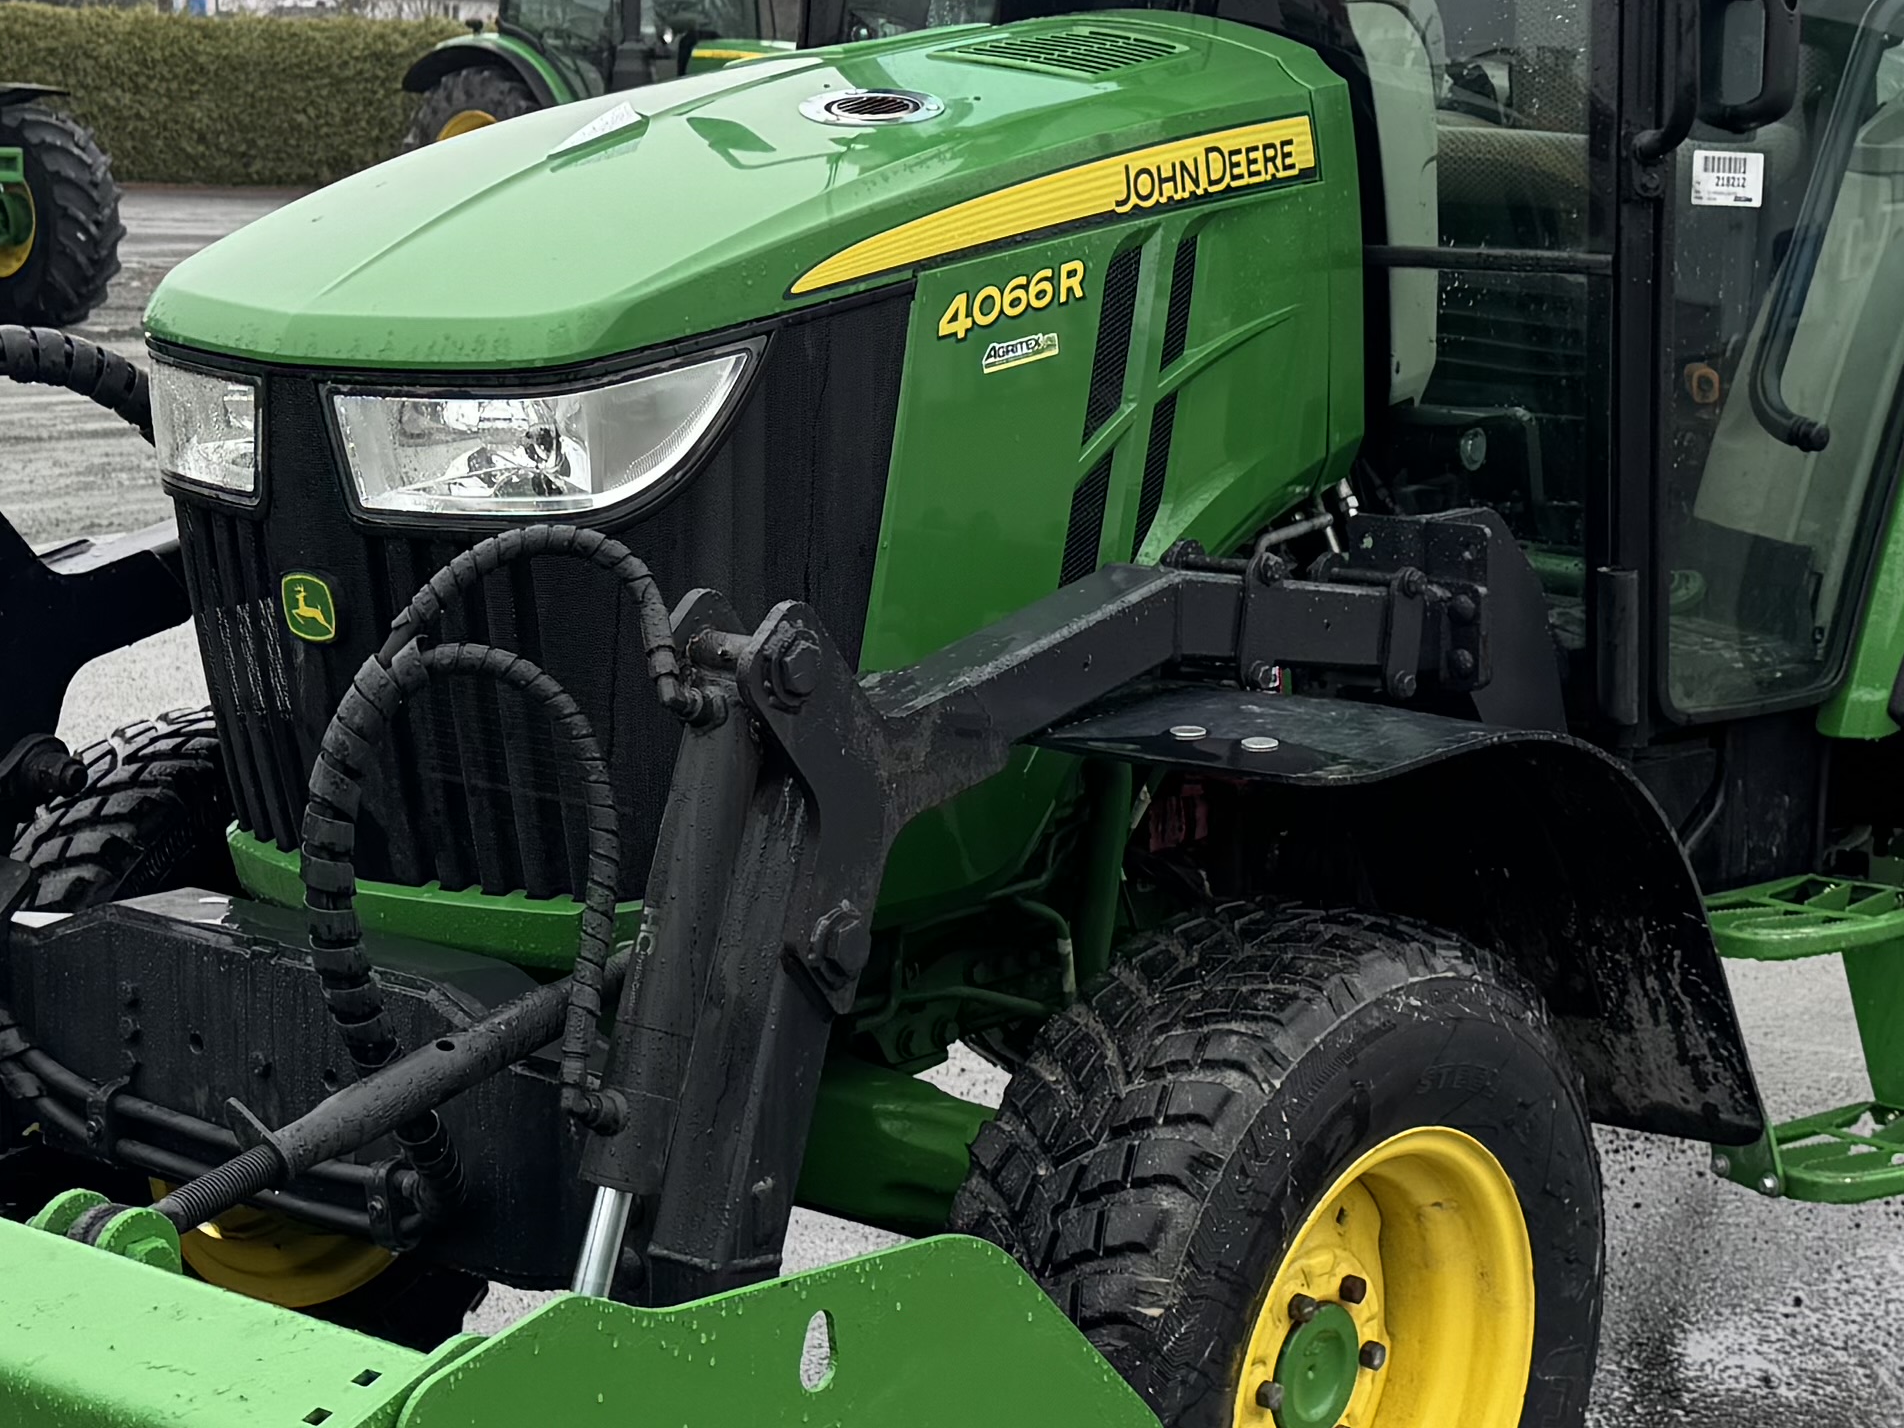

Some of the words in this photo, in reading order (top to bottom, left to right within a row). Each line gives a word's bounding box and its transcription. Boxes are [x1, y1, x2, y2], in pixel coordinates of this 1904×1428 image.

[1114, 156, 1202, 209] JOHN
[1203, 138, 1298, 189] DEERE
[938, 260, 1084, 340] 4066R
[984, 336, 1042, 362] AGRITEX
